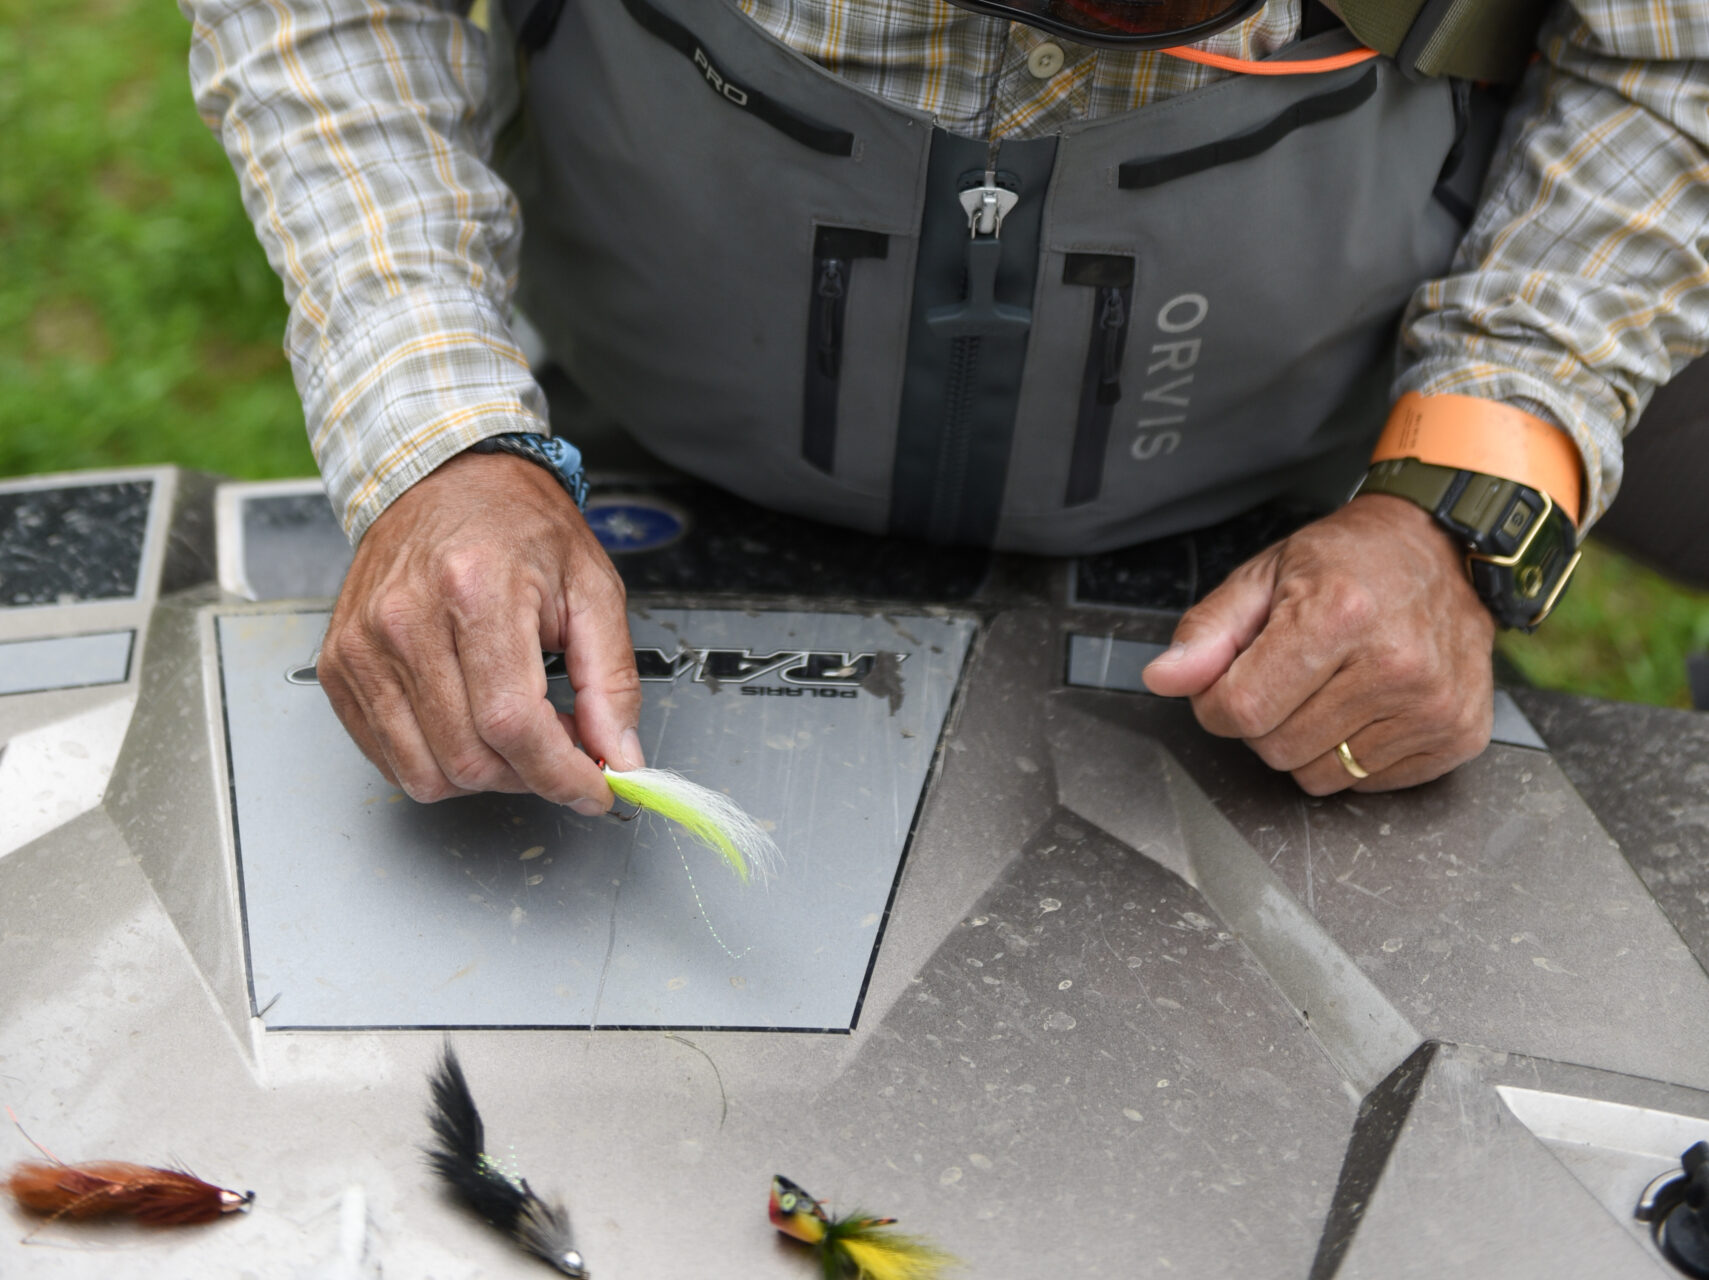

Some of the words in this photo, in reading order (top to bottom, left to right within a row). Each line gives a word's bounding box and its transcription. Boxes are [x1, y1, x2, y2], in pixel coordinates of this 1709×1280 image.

[694, 48, 748, 106] PRO
[1131, 293, 1208, 460] ORVIS
[741, 686, 858, 699] POLARIS
